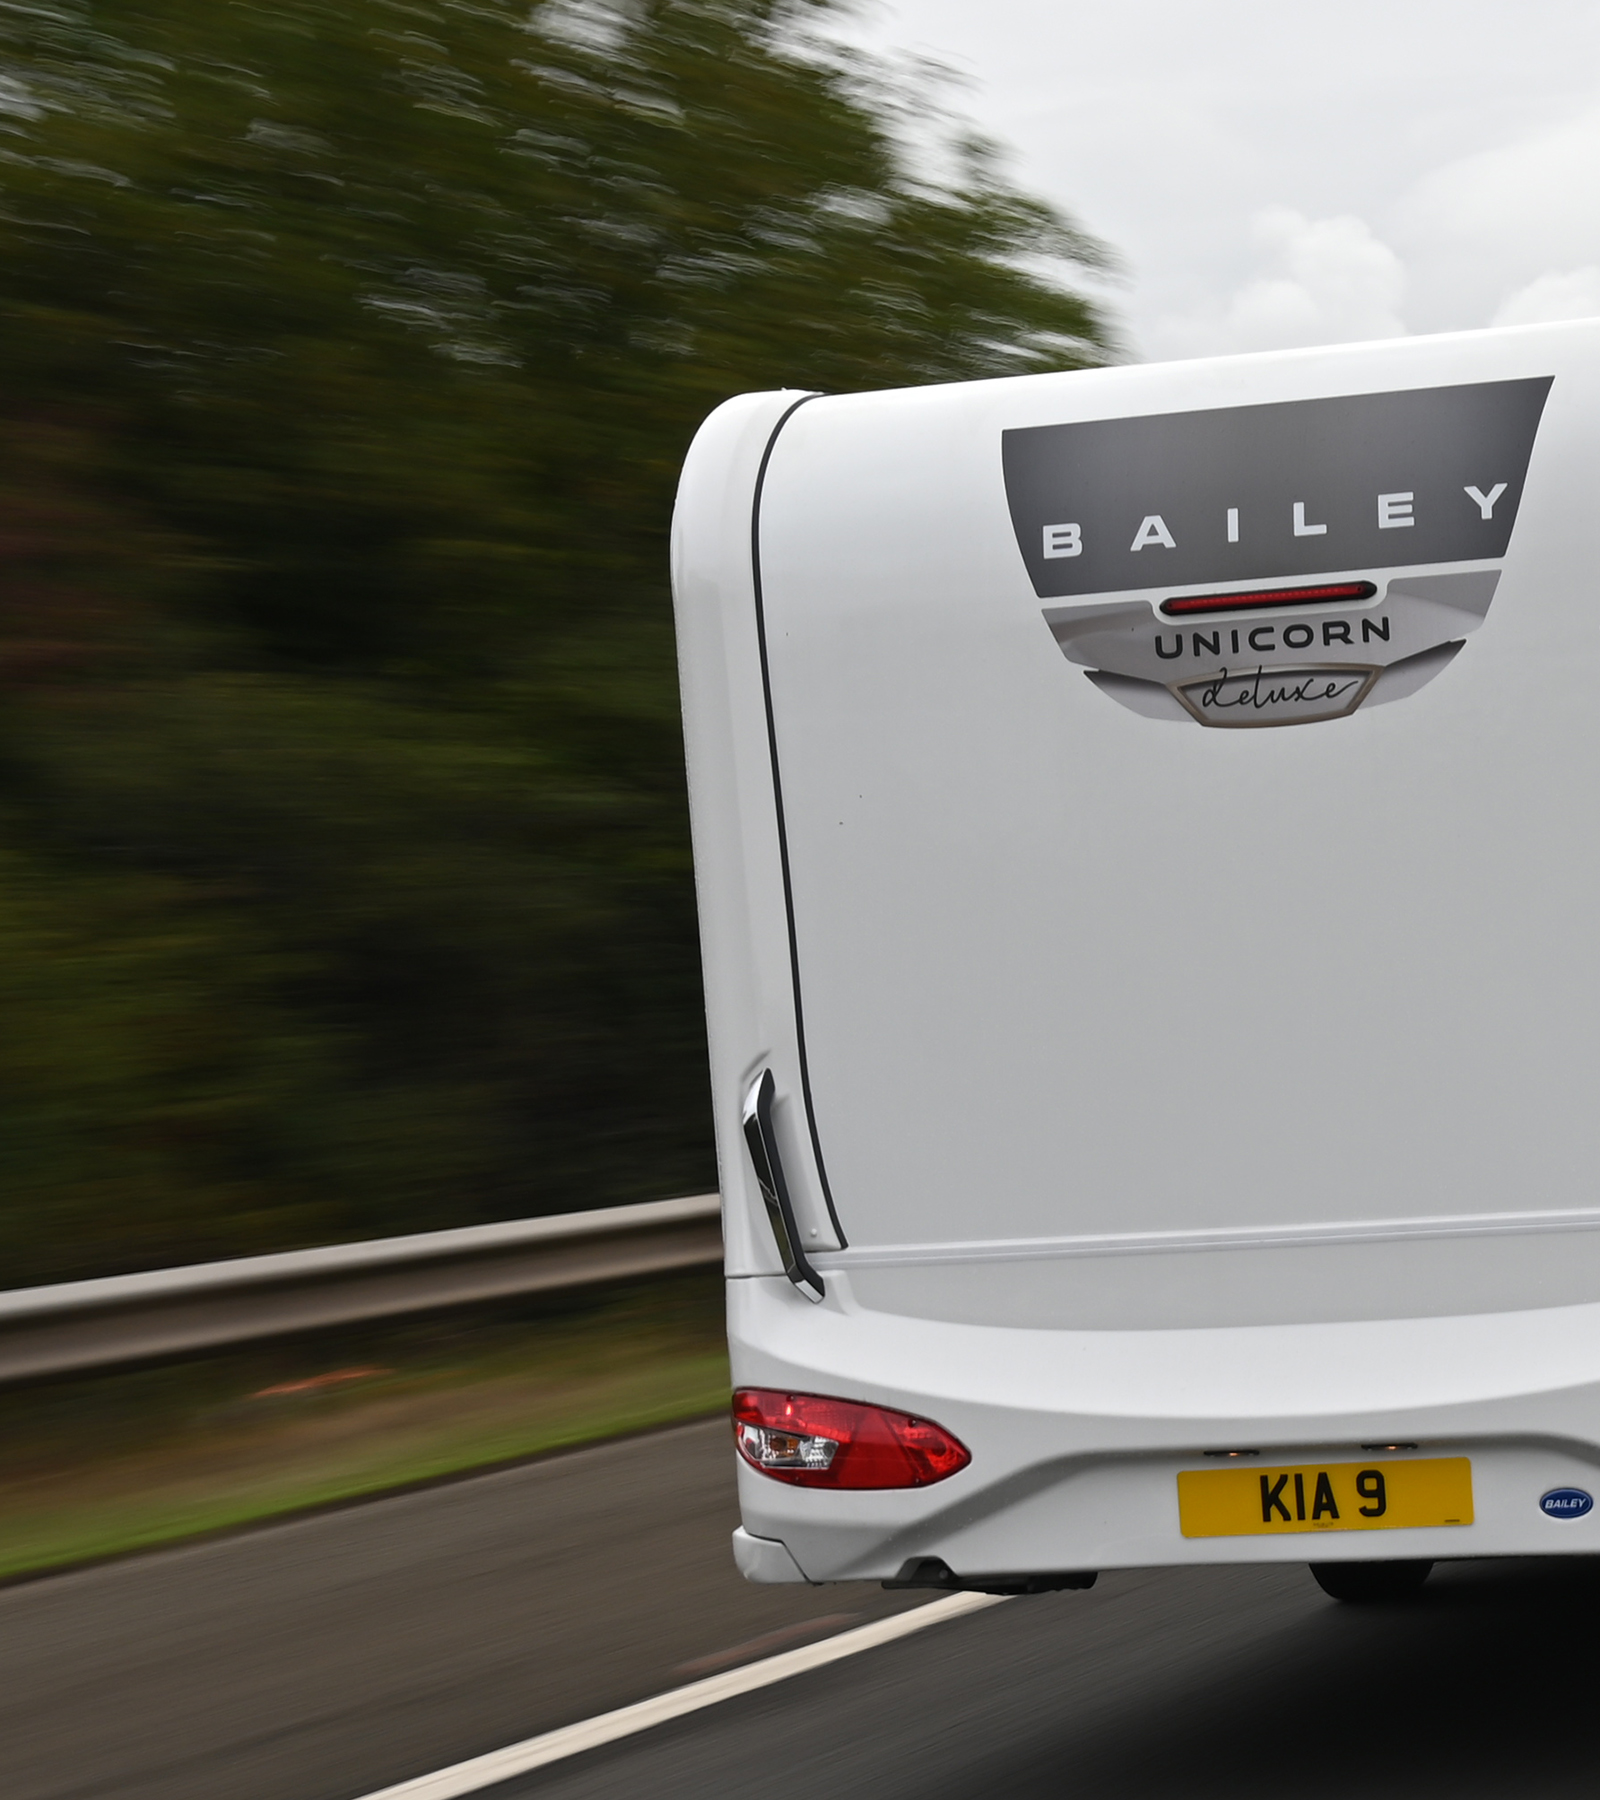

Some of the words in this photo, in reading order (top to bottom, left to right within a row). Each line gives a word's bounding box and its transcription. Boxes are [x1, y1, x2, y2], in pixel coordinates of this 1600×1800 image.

[1042, 482, 1508, 559] BAILEY
[1154, 616, 1390, 659] UNICORN
[1202, 666, 1359, 709] deluxe
[1259, 1472, 1340, 1522] KIA
[1356, 1469, 1387, 1517] 9
[1545, 1496, 1587, 1509] BAILEY
